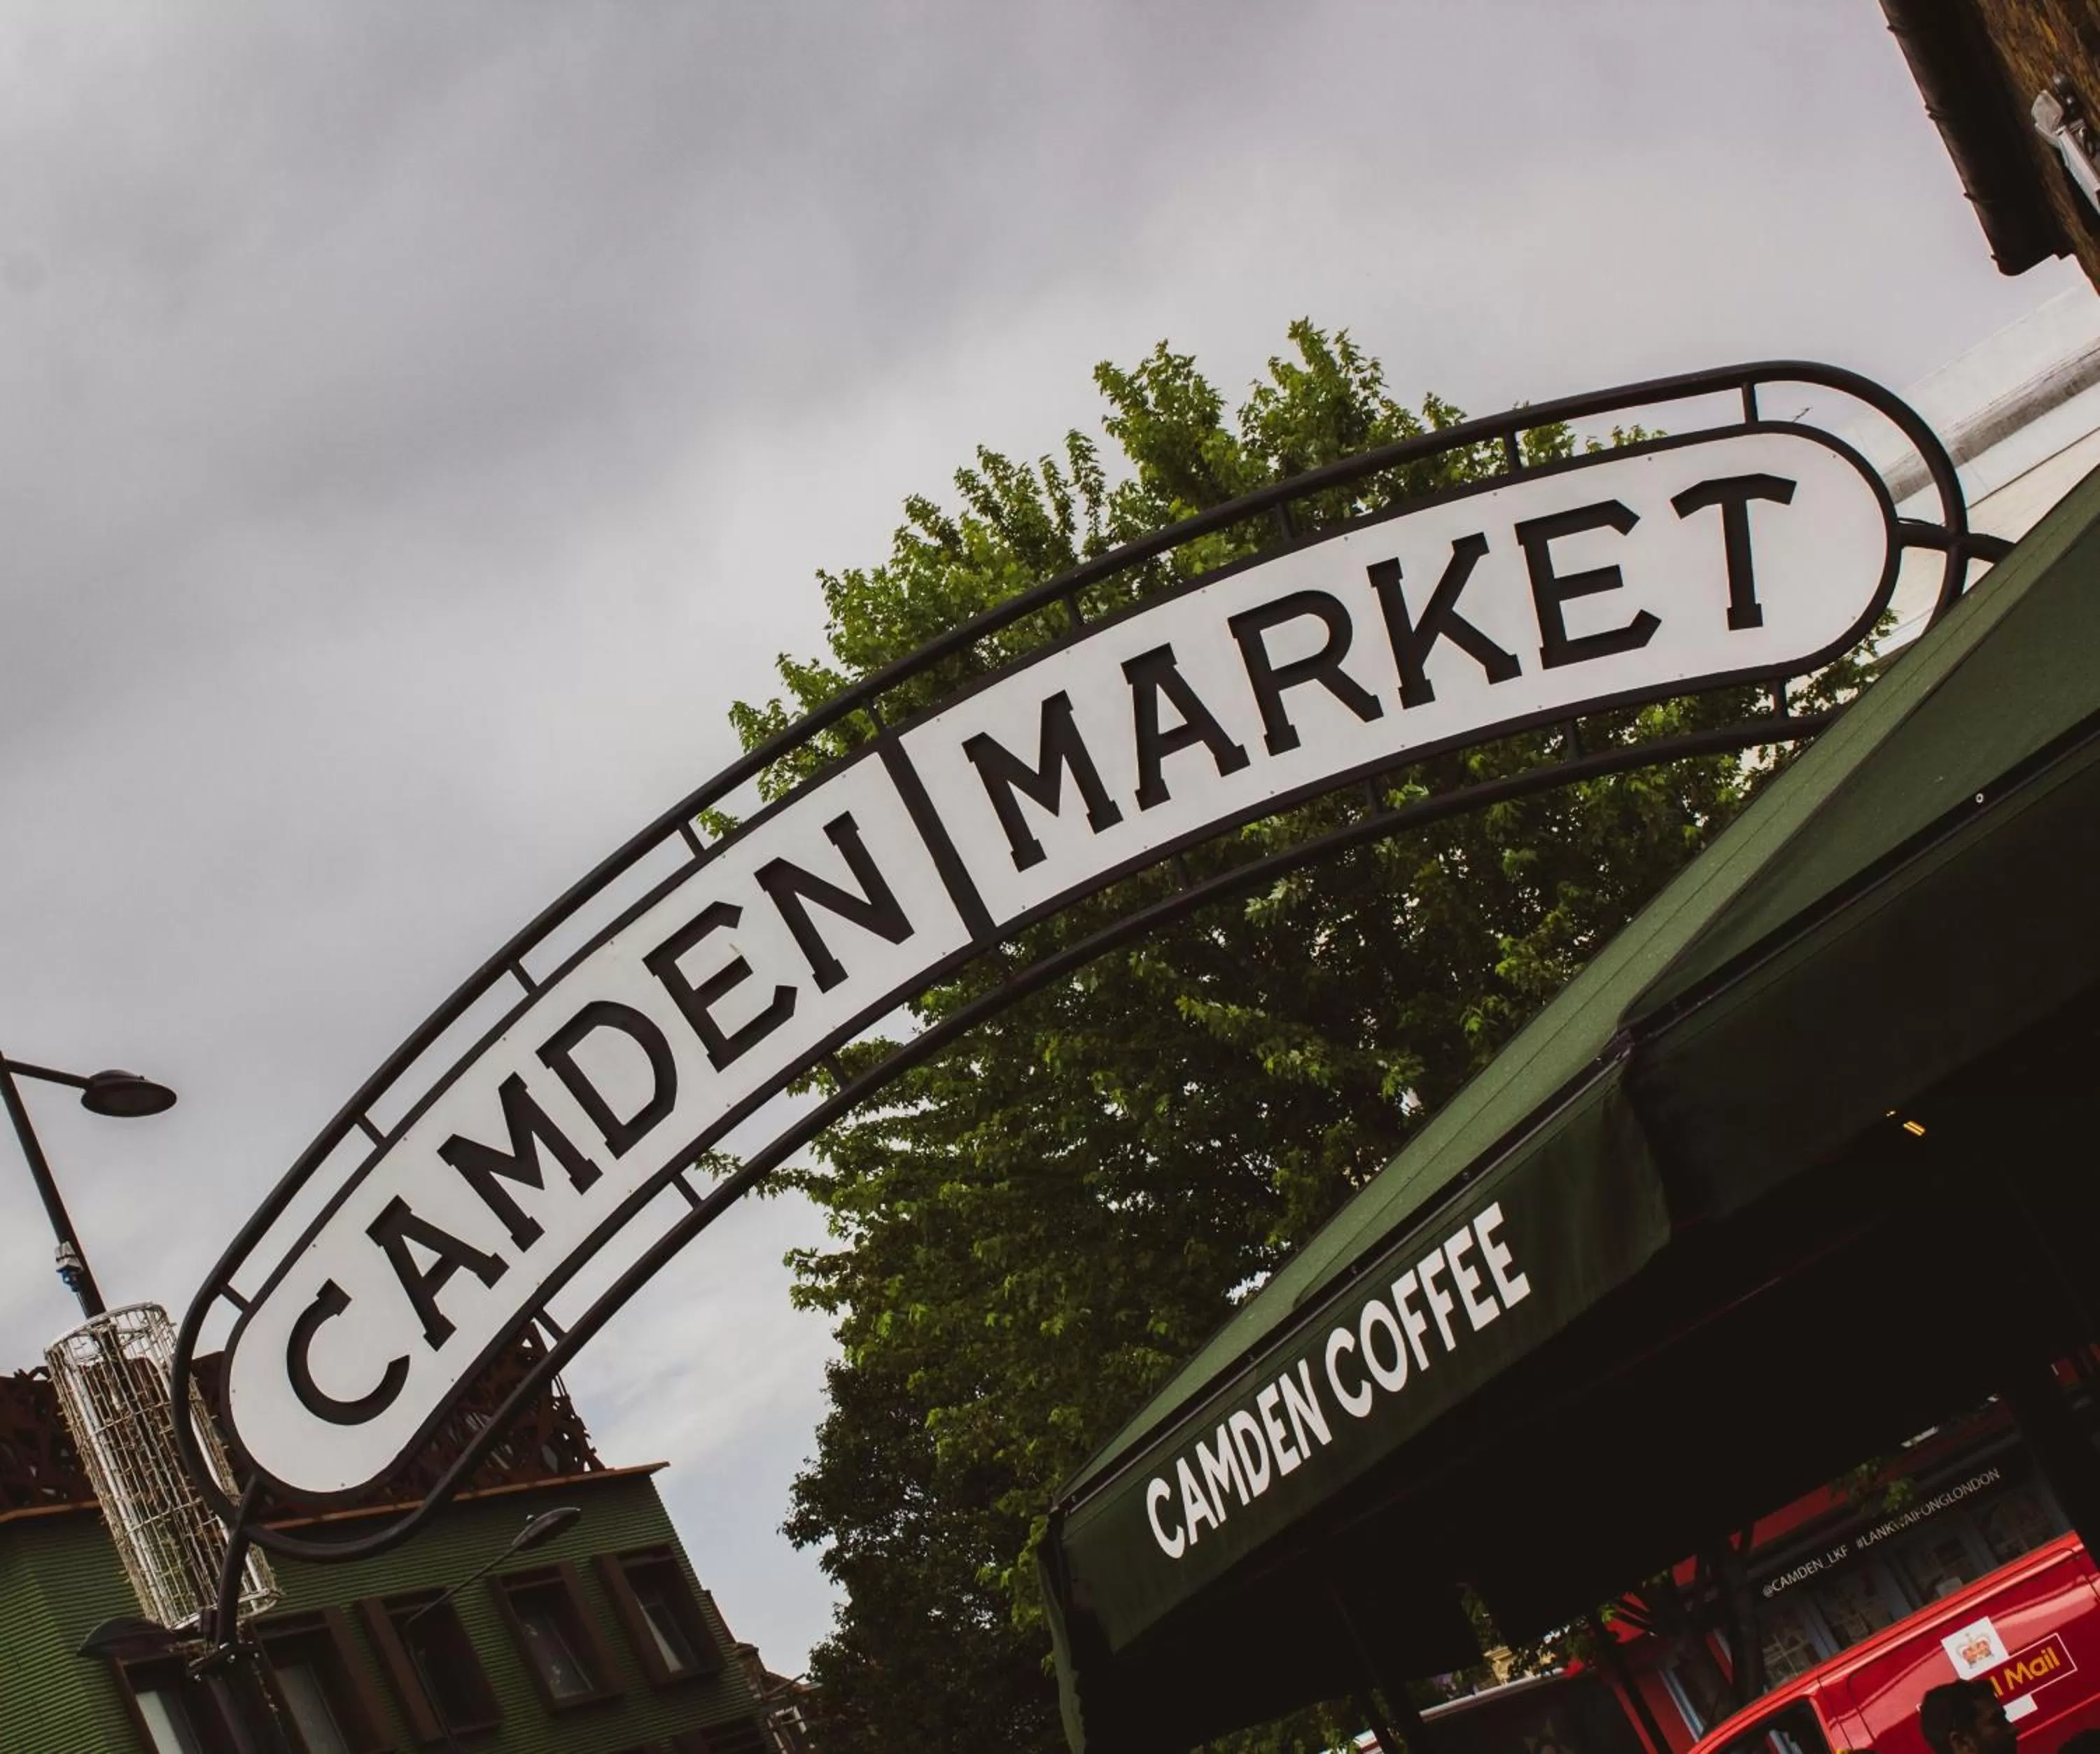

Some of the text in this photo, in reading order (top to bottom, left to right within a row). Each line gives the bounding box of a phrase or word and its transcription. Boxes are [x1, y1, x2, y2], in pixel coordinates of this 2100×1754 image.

[286, 472, 1798, 1426] CAMDEN MARKET
[1146, 1202, 1531, 1559] CAMDEN COFFEE
[2003, 1646, 2061, 1691] Mail
